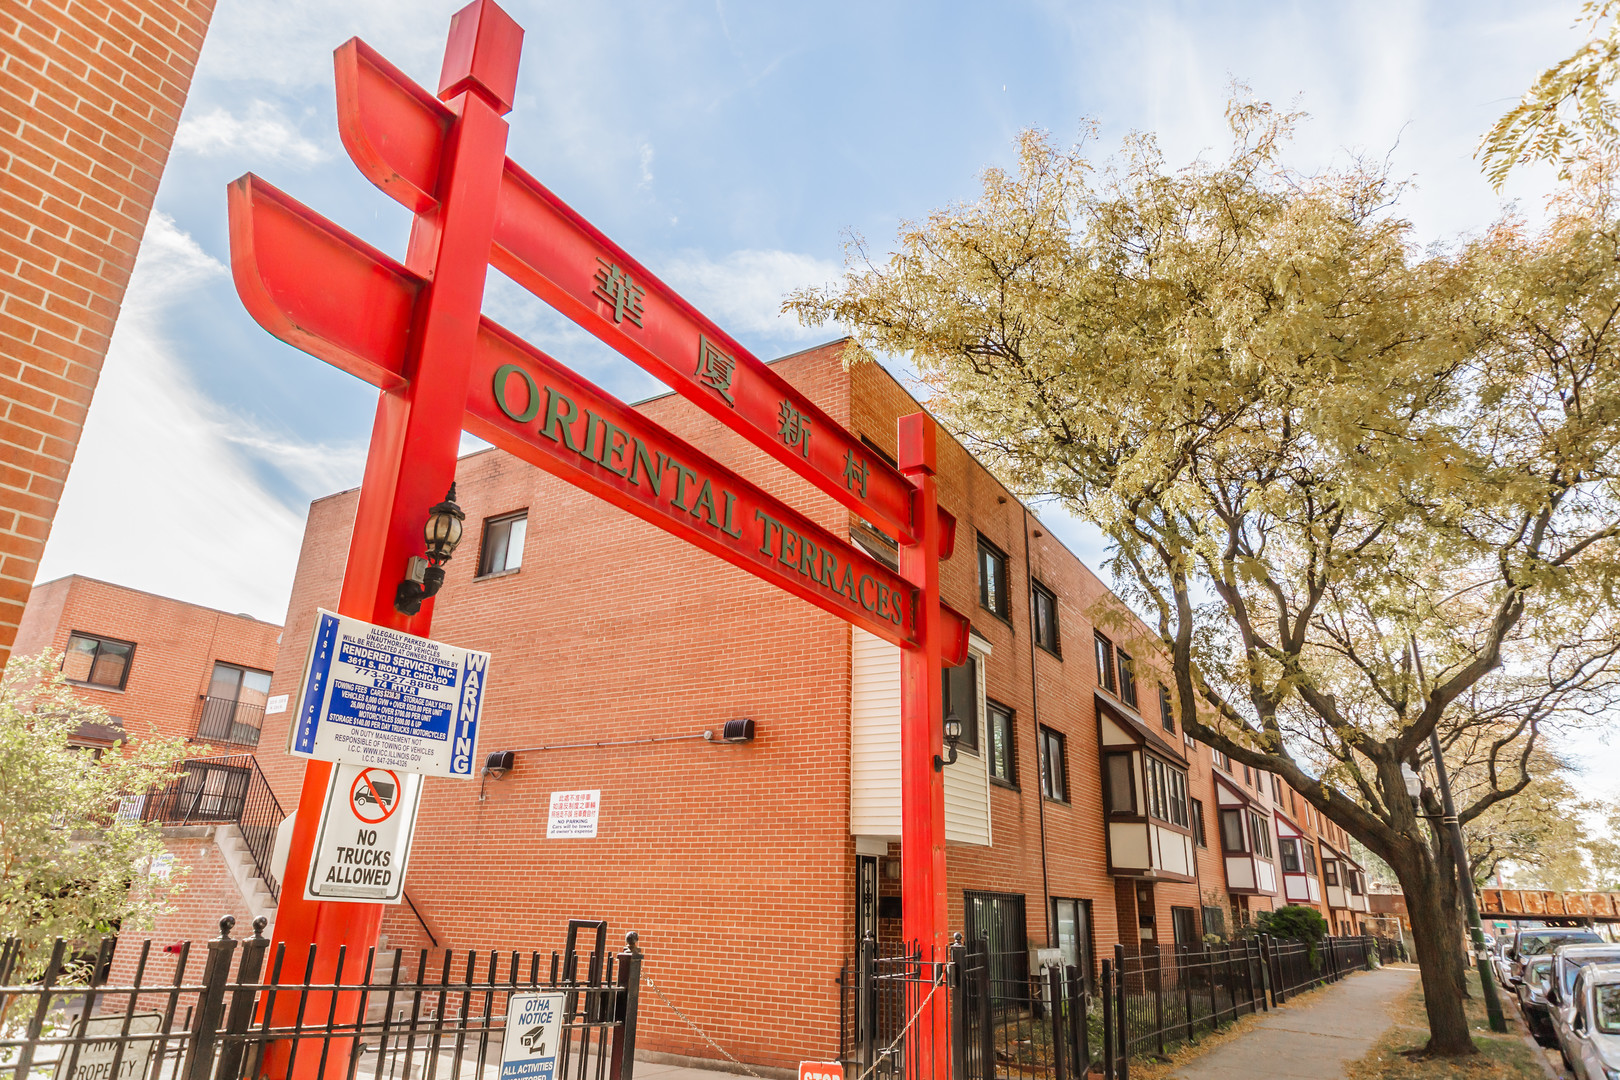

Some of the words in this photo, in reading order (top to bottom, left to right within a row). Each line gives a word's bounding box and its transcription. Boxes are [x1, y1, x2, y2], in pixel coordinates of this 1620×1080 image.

[492, 363, 742, 539] ORIENTAL
[755, 508, 904, 626] TERRACES
[320, 619, 333, 660] VISA
[366, 634, 412, 650] UNAUTHORIZED
[413, 645, 440, 657] VEHICLES
[370, 628, 402, 641] ILLEGALLY
[403, 636, 426, 647] PARKED
[342, 634, 356, 642] WILL
[366, 640, 397, 652] RELOCATED
[405, 650, 427, 660] OWNERS
[428, 656, 450, 666] EXPENSE
[341, 643, 391, 663] RENDERED
[392, 655, 436, 676] SERVICES,
[437, 666, 455, 678] INC.
[347, 655, 366, 666] 3611
[377, 662, 398, 673] IRON
[400, 668, 412, 676] ST.
[413, 671, 447, 684] CHICAGO
[313, 672, 322, 692] MC
[353, 666, 439, 690] 773-927-8888
[334, 680, 354, 690] TOWING
[354, 684, 367, 693] FEES
[369, 688, 384, 696] CARS
[402, 694, 424, 705] STORAGE
[424, 699, 437, 707] DAILY
[391, 683, 415, 694] RTV-R
[340, 690, 364, 701] VEHICLES
[377, 697, 389, 706] GVW
[392, 700, 406, 709] OVER
[422, 706, 432, 714] PER
[432, 708, 442, 716] UNIT
[365, 703, 377, 712] GVW
[380, 706, 394, 715] OVER
[410, 712, 420, 720] PER
[420, 714, 431, 722] UNIT
[358, 710, 393, 722] MOTORCYCLES
[453, 653, 487, 774] WARNING
[302, 705, 315, 747] CASH
[328, 713, 353, 723] STORAGE
[370, 720, 381, 728] PER
[380, 722, 391, 730] DAY
[391, 724, 410, 733] TRUCKS
[412, 727, 446, 739] MOTORCYCLES
[334, 734, 372, 745] RESPONSIBLE
[381, 741, 401, 750] TOWING
[410, 746, 434, 755] VEHICLES
[374, 732, 410, 743] MANAGEMENT
[357, 829, 377, 846] NO
[337, 847, 391, 867] TRUCKS
[326, 866, 392, 886] ALLOWED
[525, 999, 550, 1012] OTHA
[518, 1012, 553, 1025] NOTICE
[72, 1060, 137, 1080] ROPETY
[503, 1066, 516, 1076] ALL
[517, 1062, 554, 1074] ACTIVITIES
